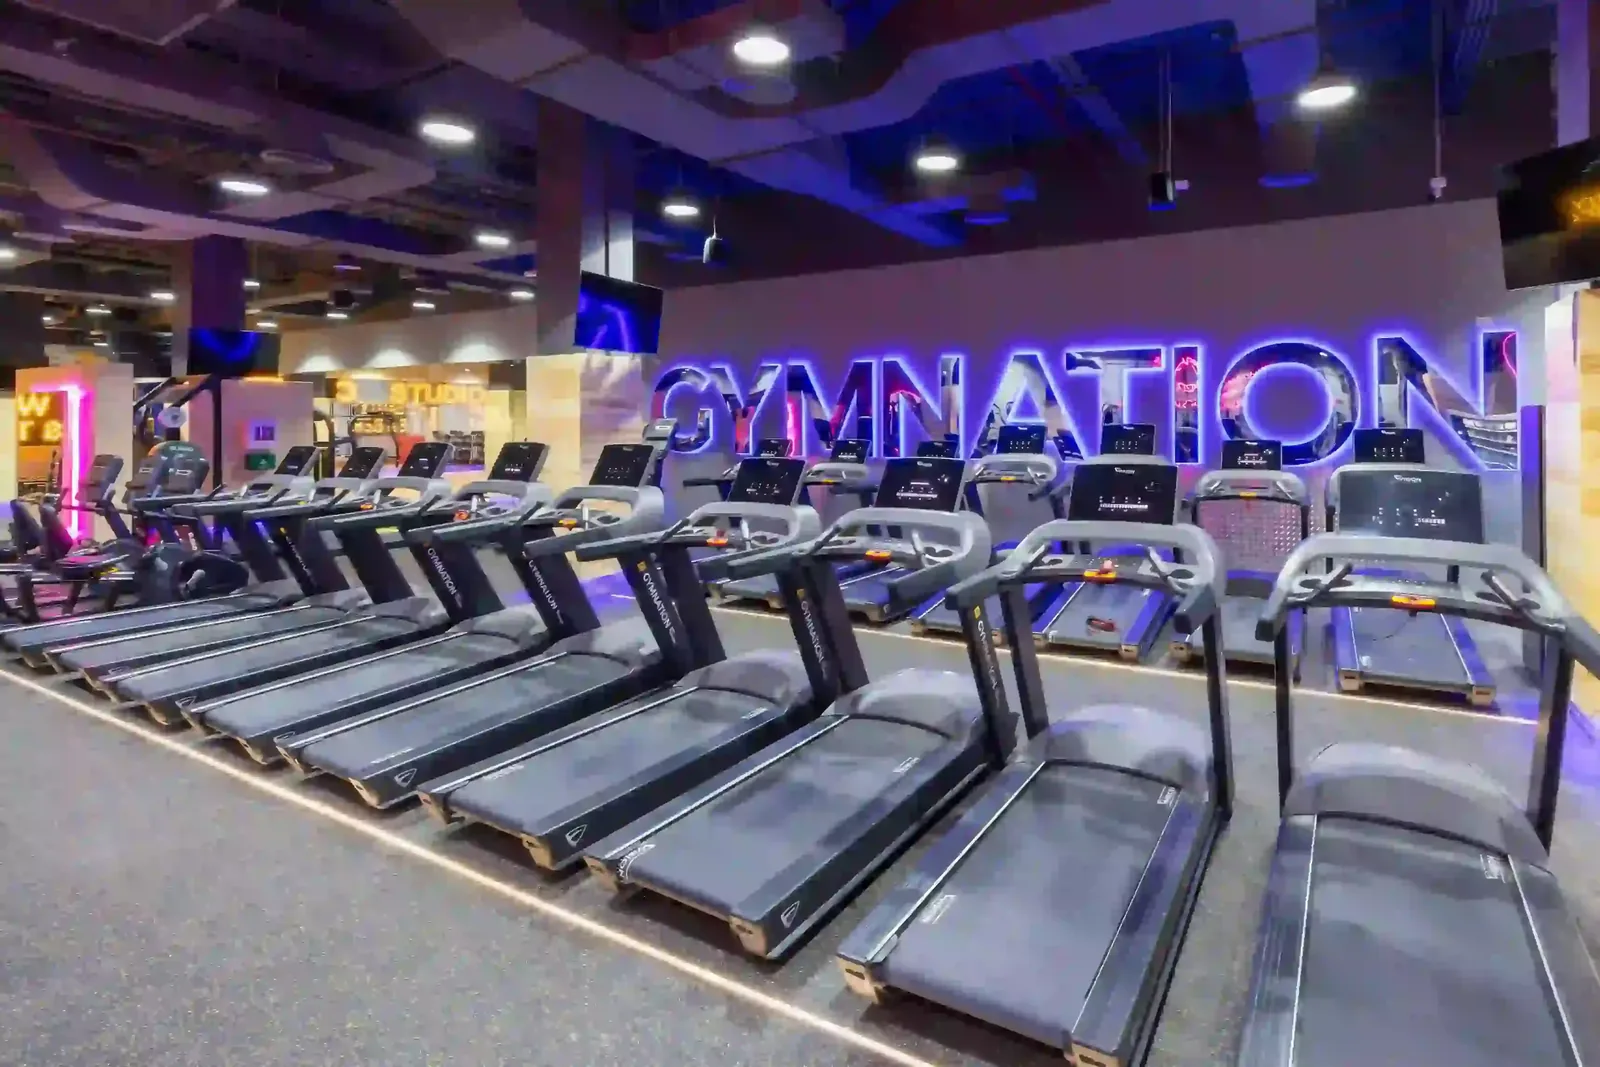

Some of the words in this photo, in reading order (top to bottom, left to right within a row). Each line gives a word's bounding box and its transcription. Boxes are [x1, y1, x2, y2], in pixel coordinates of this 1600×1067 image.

[650, 329, 1520, 472] GYMNATION
[427, 547, 458, 596] GYMNATION
[642, 572, 672, 629] GYMNATION
[801, 600, 825, 663] GYMNATION
